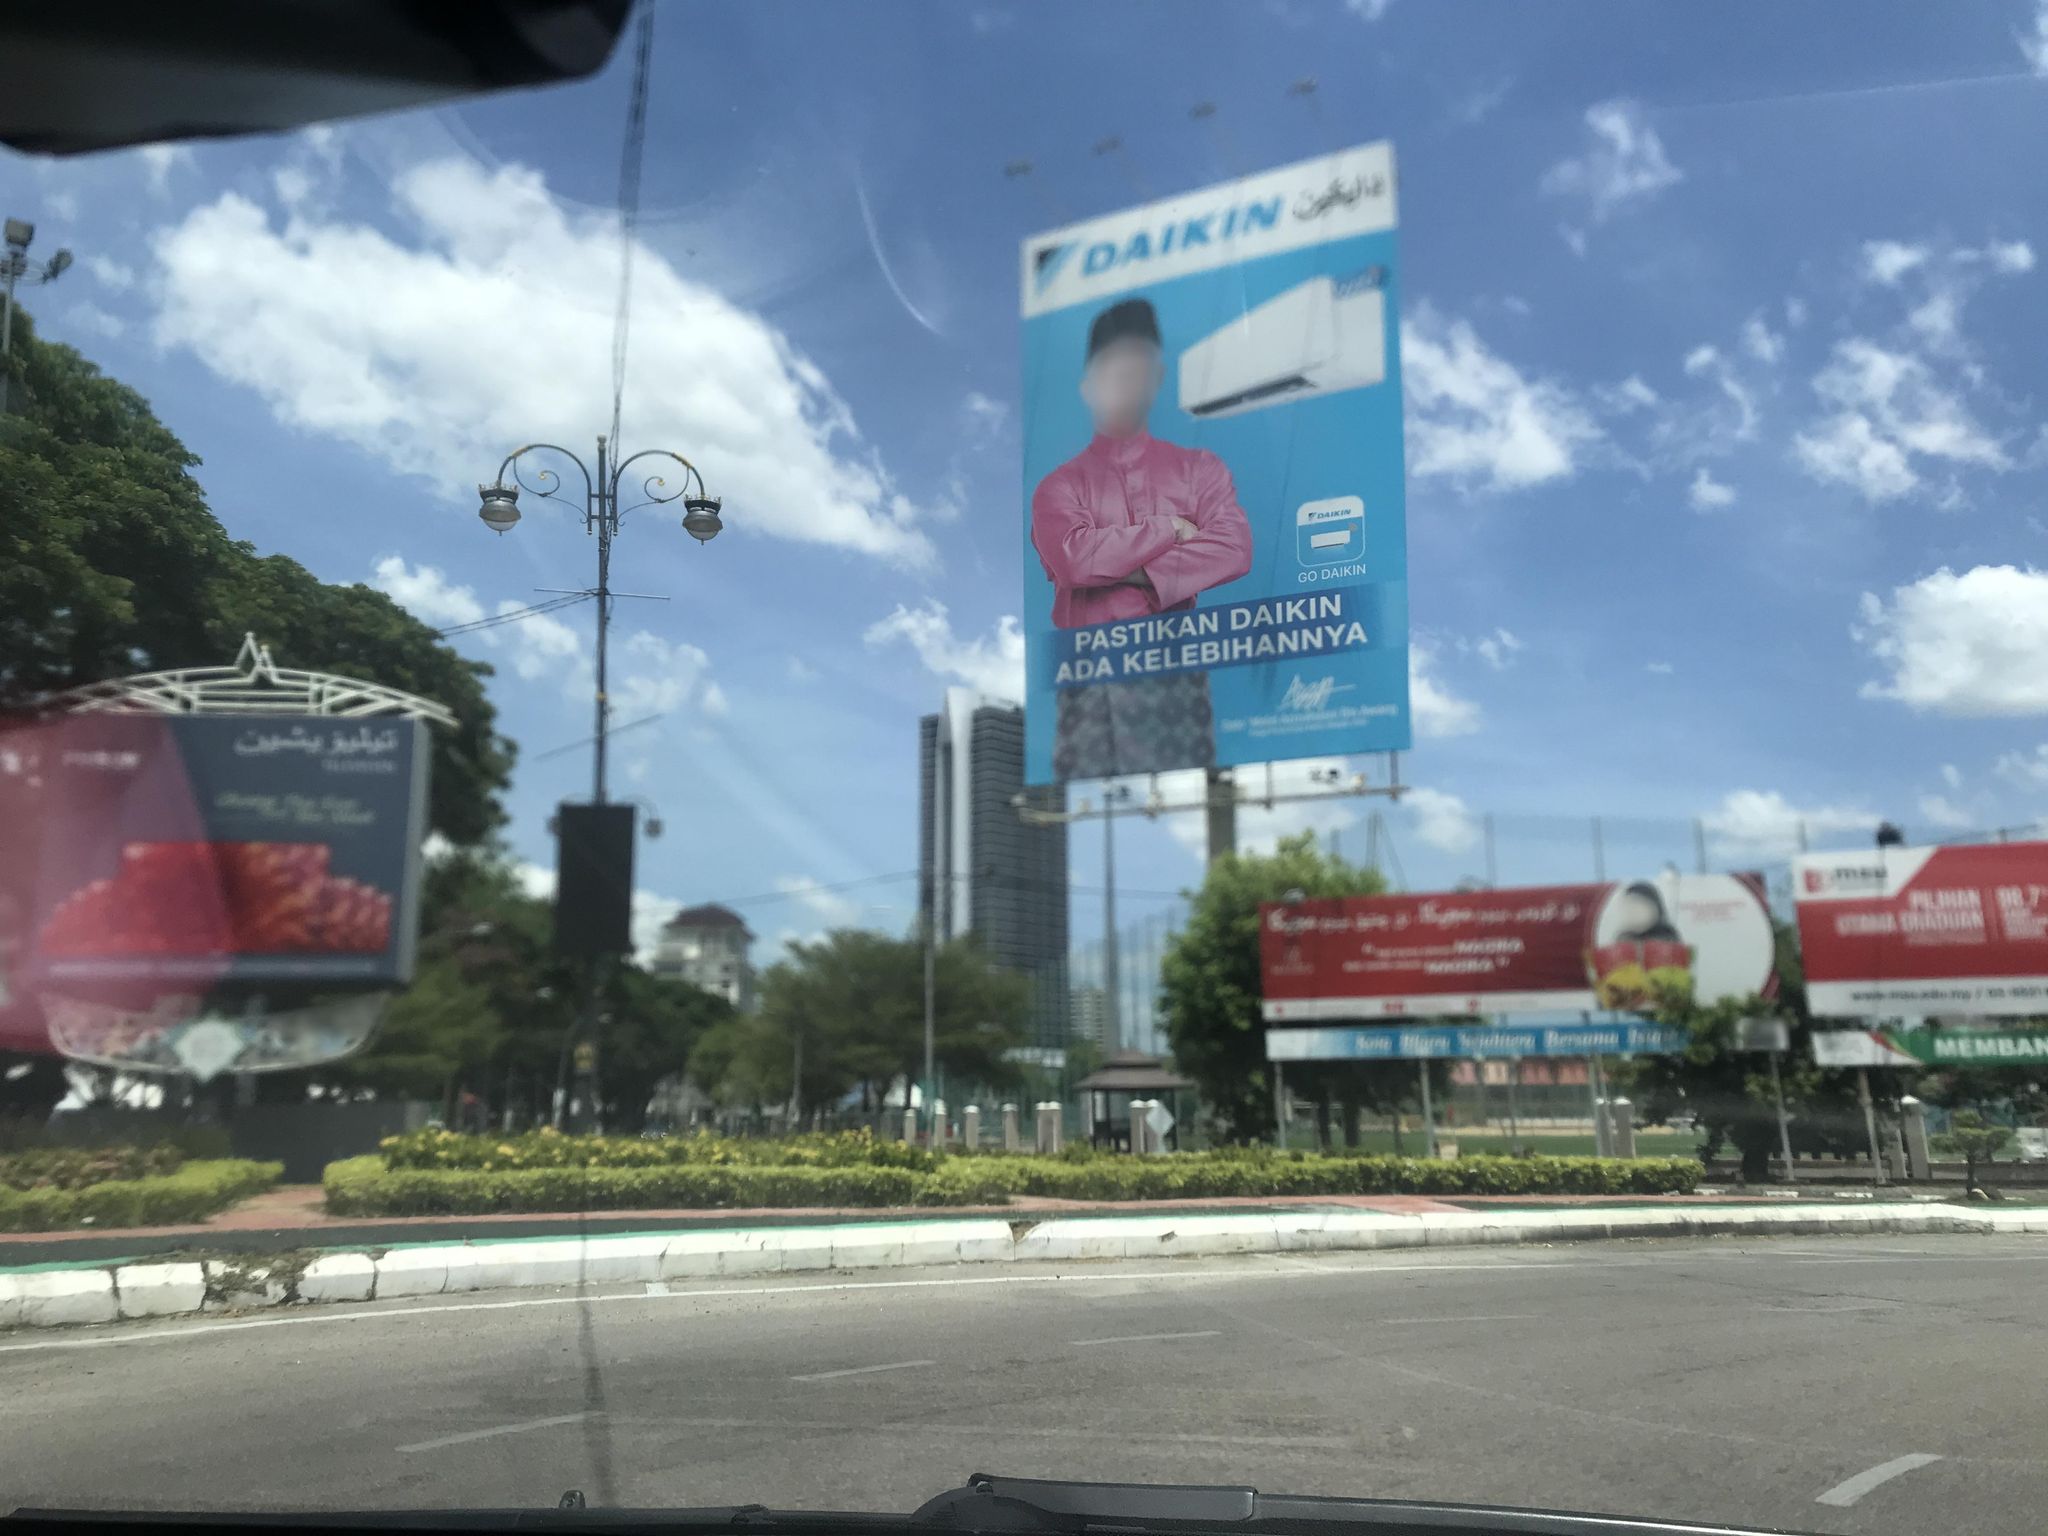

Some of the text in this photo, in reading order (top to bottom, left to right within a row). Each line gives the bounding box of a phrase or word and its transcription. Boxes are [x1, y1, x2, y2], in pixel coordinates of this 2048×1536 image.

[1082, 194, 1282, 276] DAIKIN
[1317, 508, 1352, 519] DAIKIN
[1298, 563, 1366, 583] GO DAIKIN
[1054, 621, 1369, 685] ADA KELEBIHANNYA
[1074, 593, 1343, 653] PASTIKAN DAIKIN
